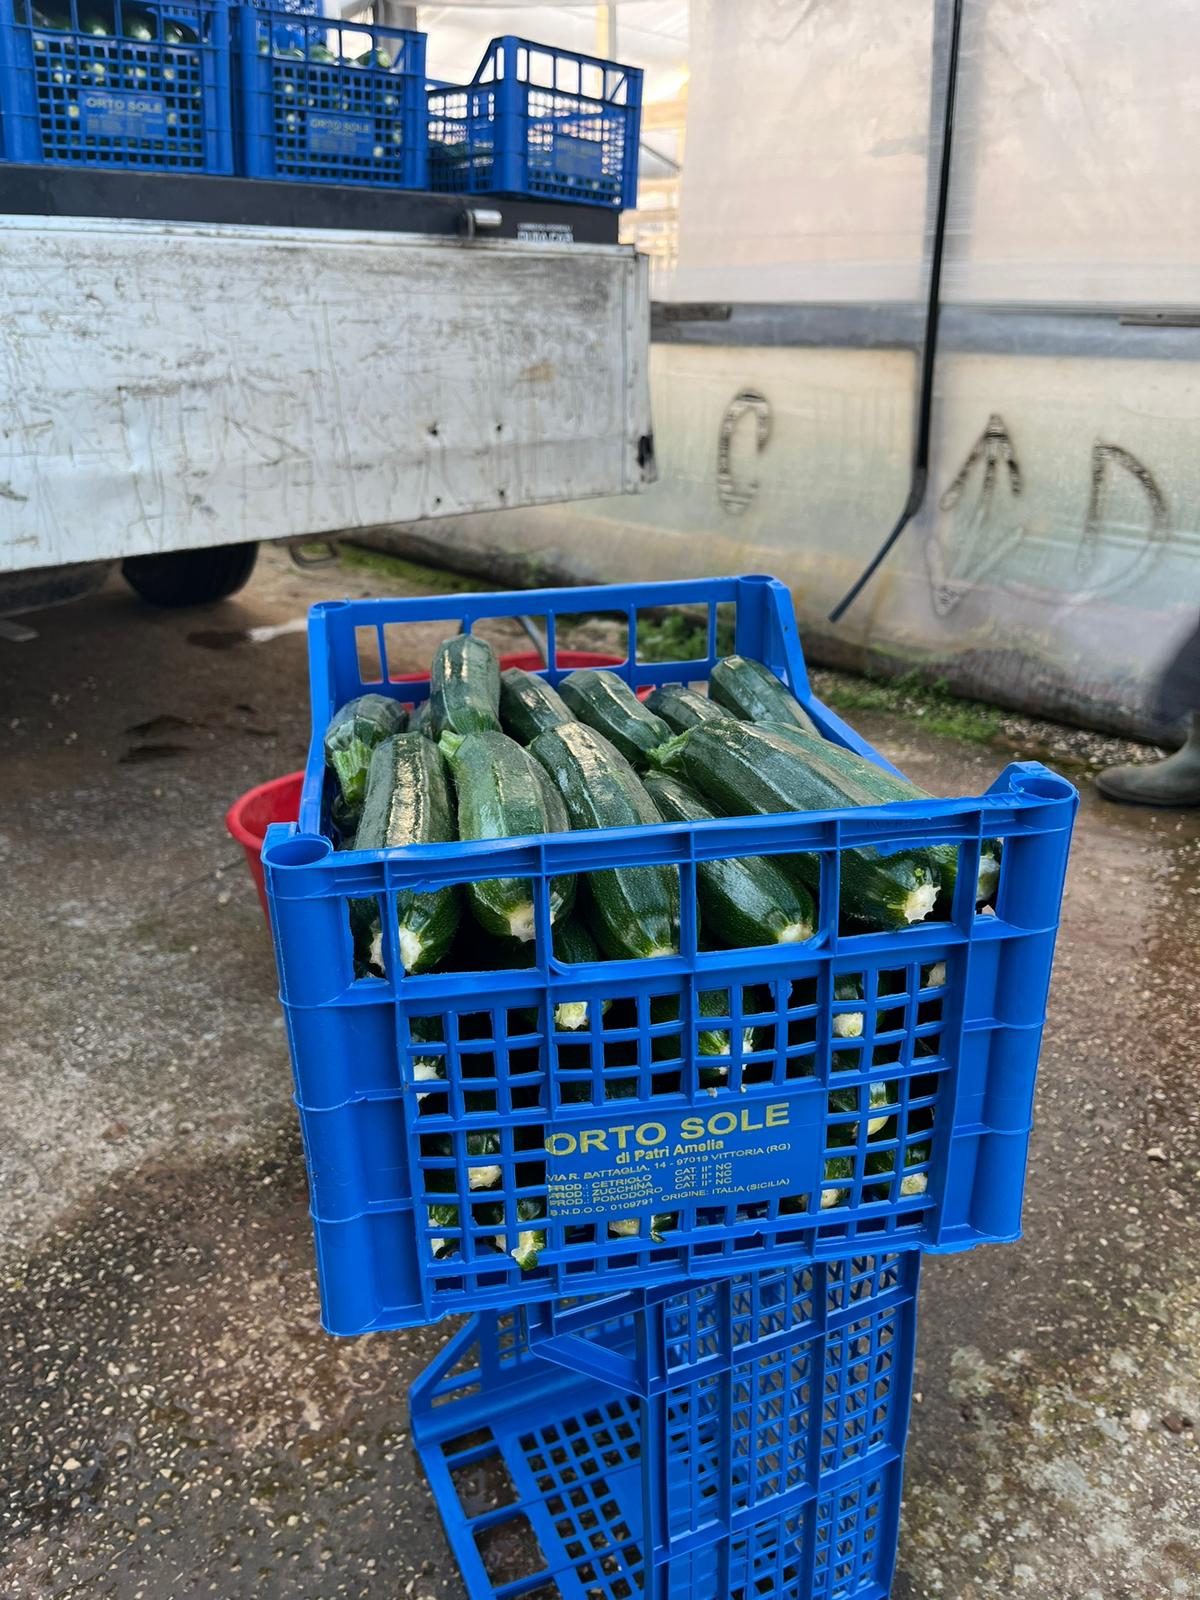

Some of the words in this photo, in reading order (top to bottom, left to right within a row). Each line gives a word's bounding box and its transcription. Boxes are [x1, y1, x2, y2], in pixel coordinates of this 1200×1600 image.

[86, 96, 126, 111] ORTO
[544, 1122, 667, 1156] ORTO
[680, 1102, 790, 1140] SOLE
[615, 1151, 630, 1164] di
[672, 1139, 724, 1157] Amelia
[654, 1161, 666, 1169] 14
[676, 1155, 709, 1166] 97019
[711, 1147, 764, 1161] VITTORIA
[766, 1142, 791, 1154] (RG)
[591, 1174, 652, 1189] CETRIOLO
[715, 1162, 732, 1170] NC
[591, 1181, 653, 1197] ZUCCHINA
[715, 1169, 732, 1177] NC
[592, 1187, 663, 1203] POMODORO
[610, 1197, 653, 1211] 0109791
[712, 1185, 745, 1195] ITALIA
[746, 1178, 790, 1192] (SICILIA)
